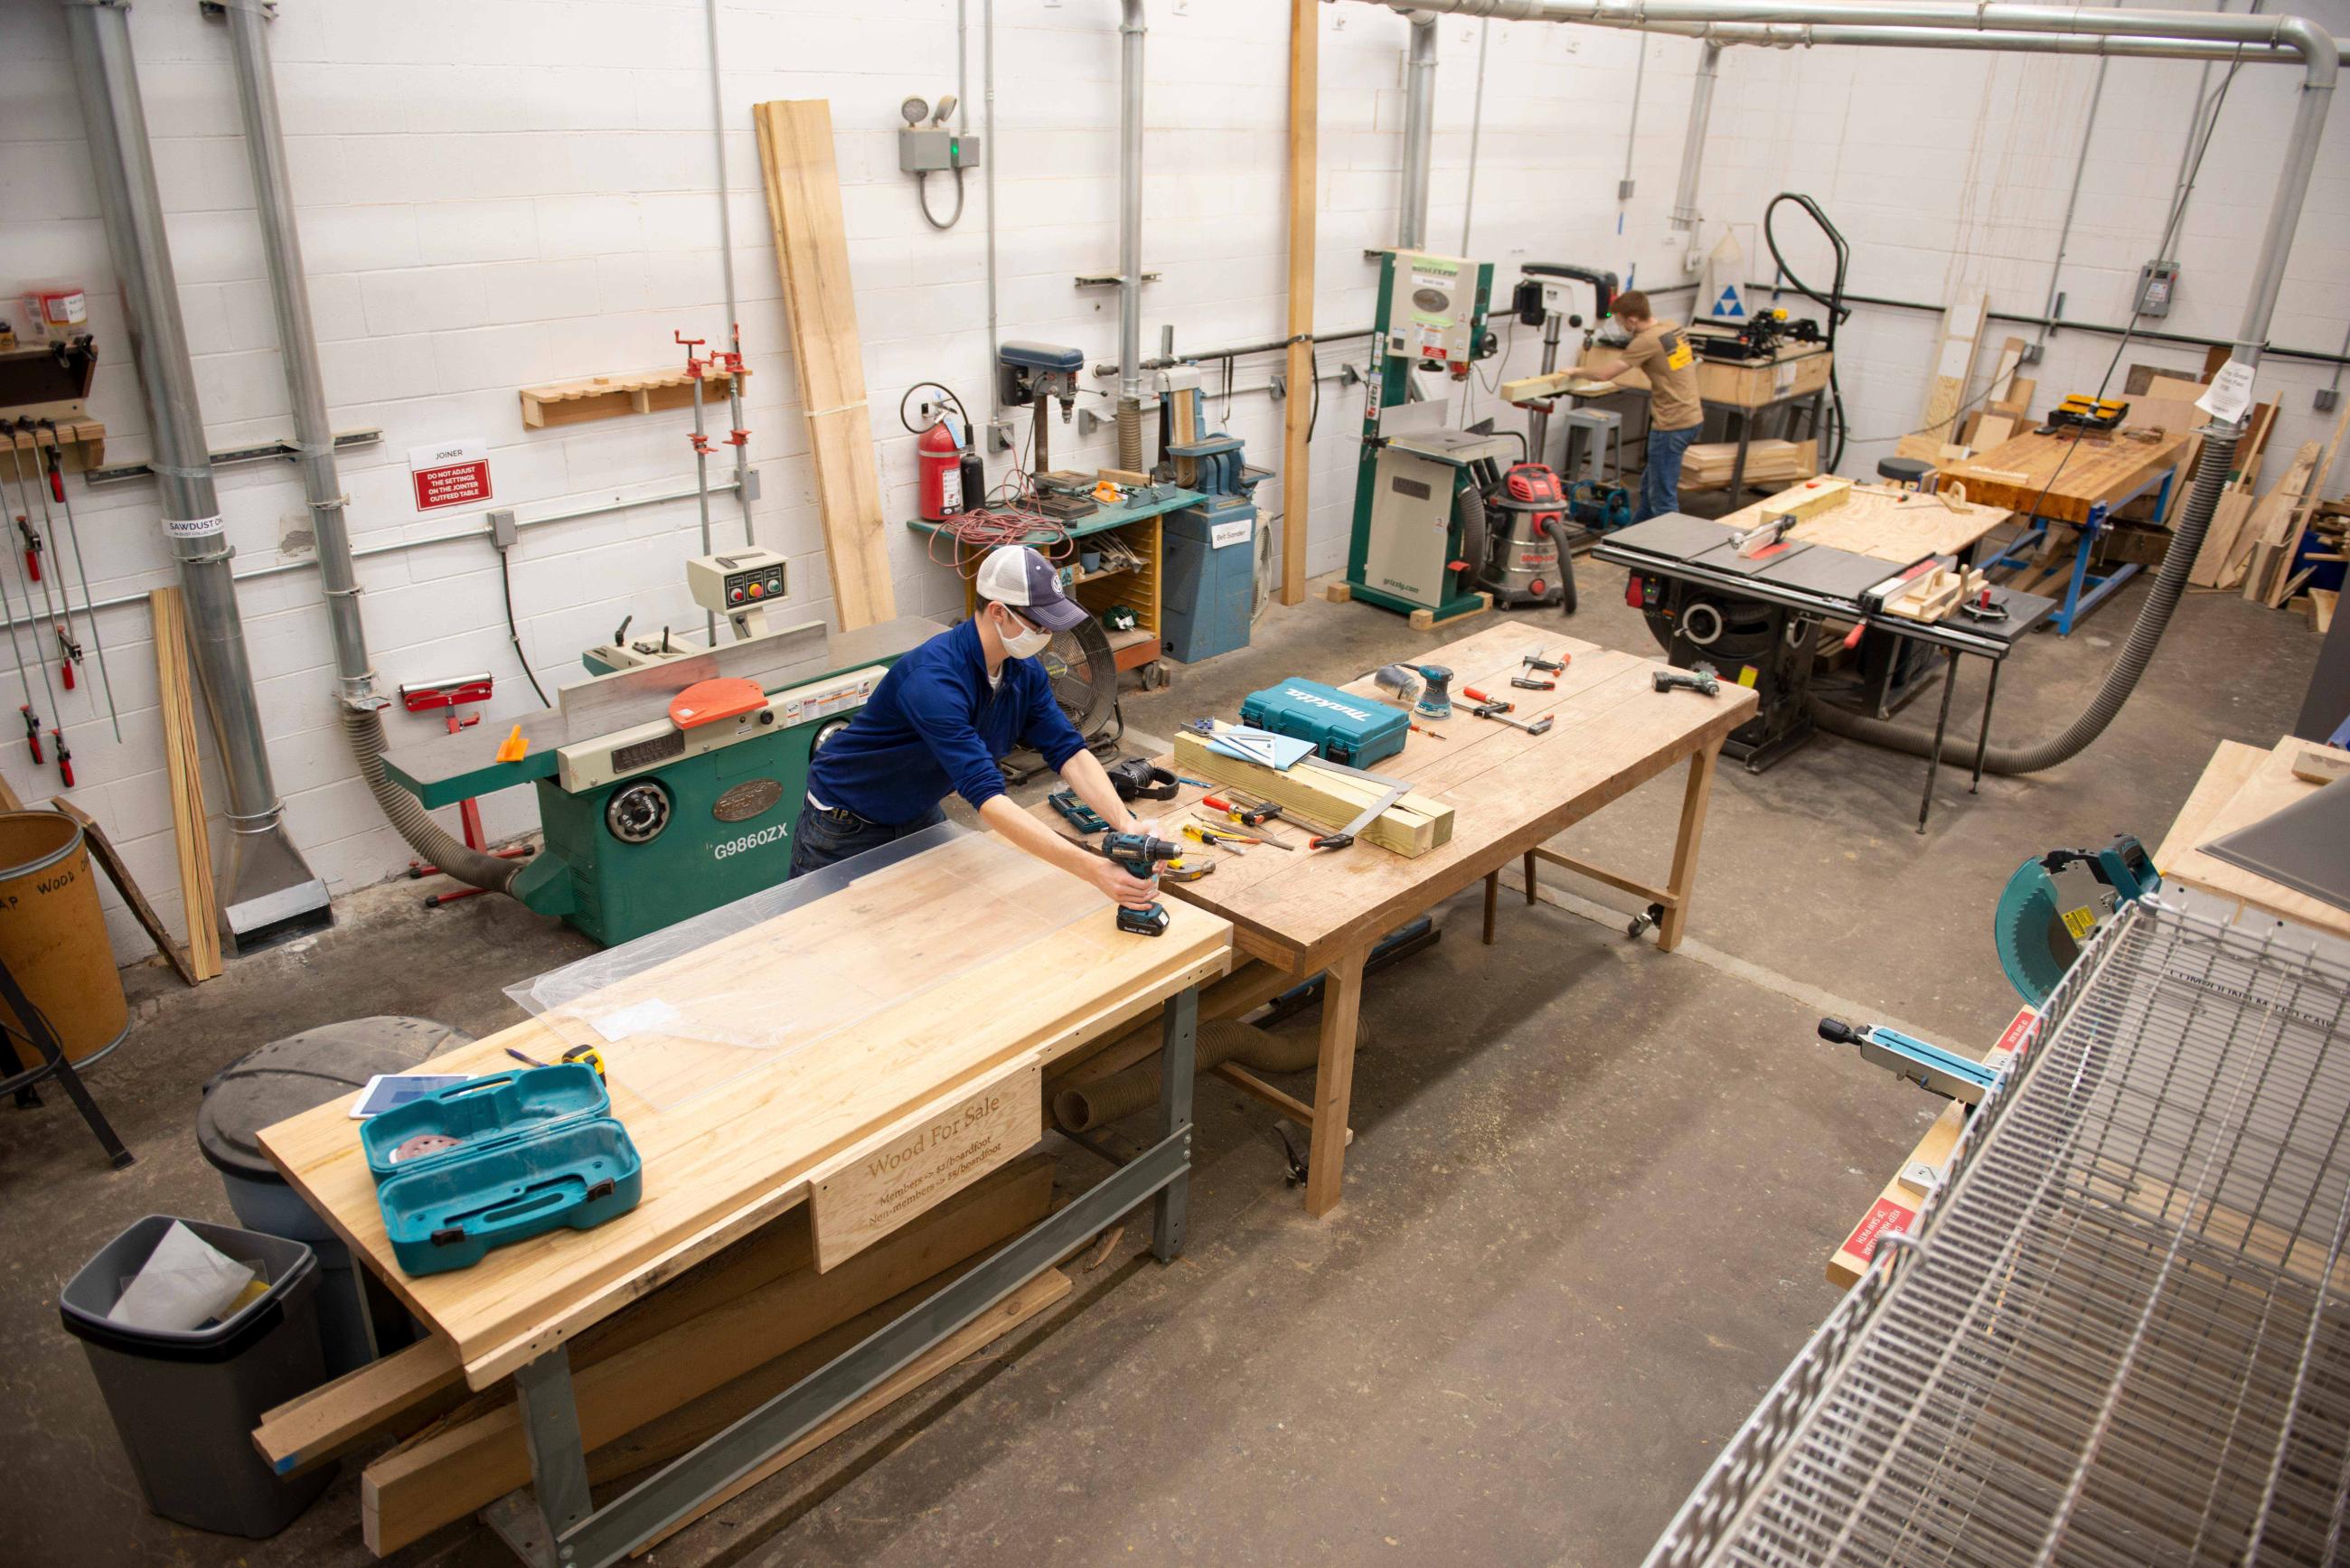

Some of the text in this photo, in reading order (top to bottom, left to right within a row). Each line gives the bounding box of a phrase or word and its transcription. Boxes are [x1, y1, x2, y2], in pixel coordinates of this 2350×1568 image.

[435, 449, 463, 460] JOINER
[452, 466, 475, 476] ADJUST
[431, 474, 475, 487] THE SETTINGS
[439, 485, 453, 493] THE
[453, 482, 478, 491] JOINTER
[430, 489, 479, 502] OUTFEED TABLE
[169, 520, 213, 530] SAWDUST
[622, 814, 633, 827] UP
[714, 822, 788, 860] G9860ZX
[37, 871, 75, 895] WOOD
[868, 1095, 1000, 1179] Wood For Sale
[879, 1176, 923, 1207] Members
[935, 1136, 992, 1175] $2/boardfoot
[869, 1184, 935, 1226] Non-members
[947, 1142, 1001, 1180] $5/boardfoot
[1887, 1209, 1901, 1223] KEEP
[1856, 1210, 1886, 1244] OF SAW PATH
[1862, 1238, 1878, 1255] CLEAR
